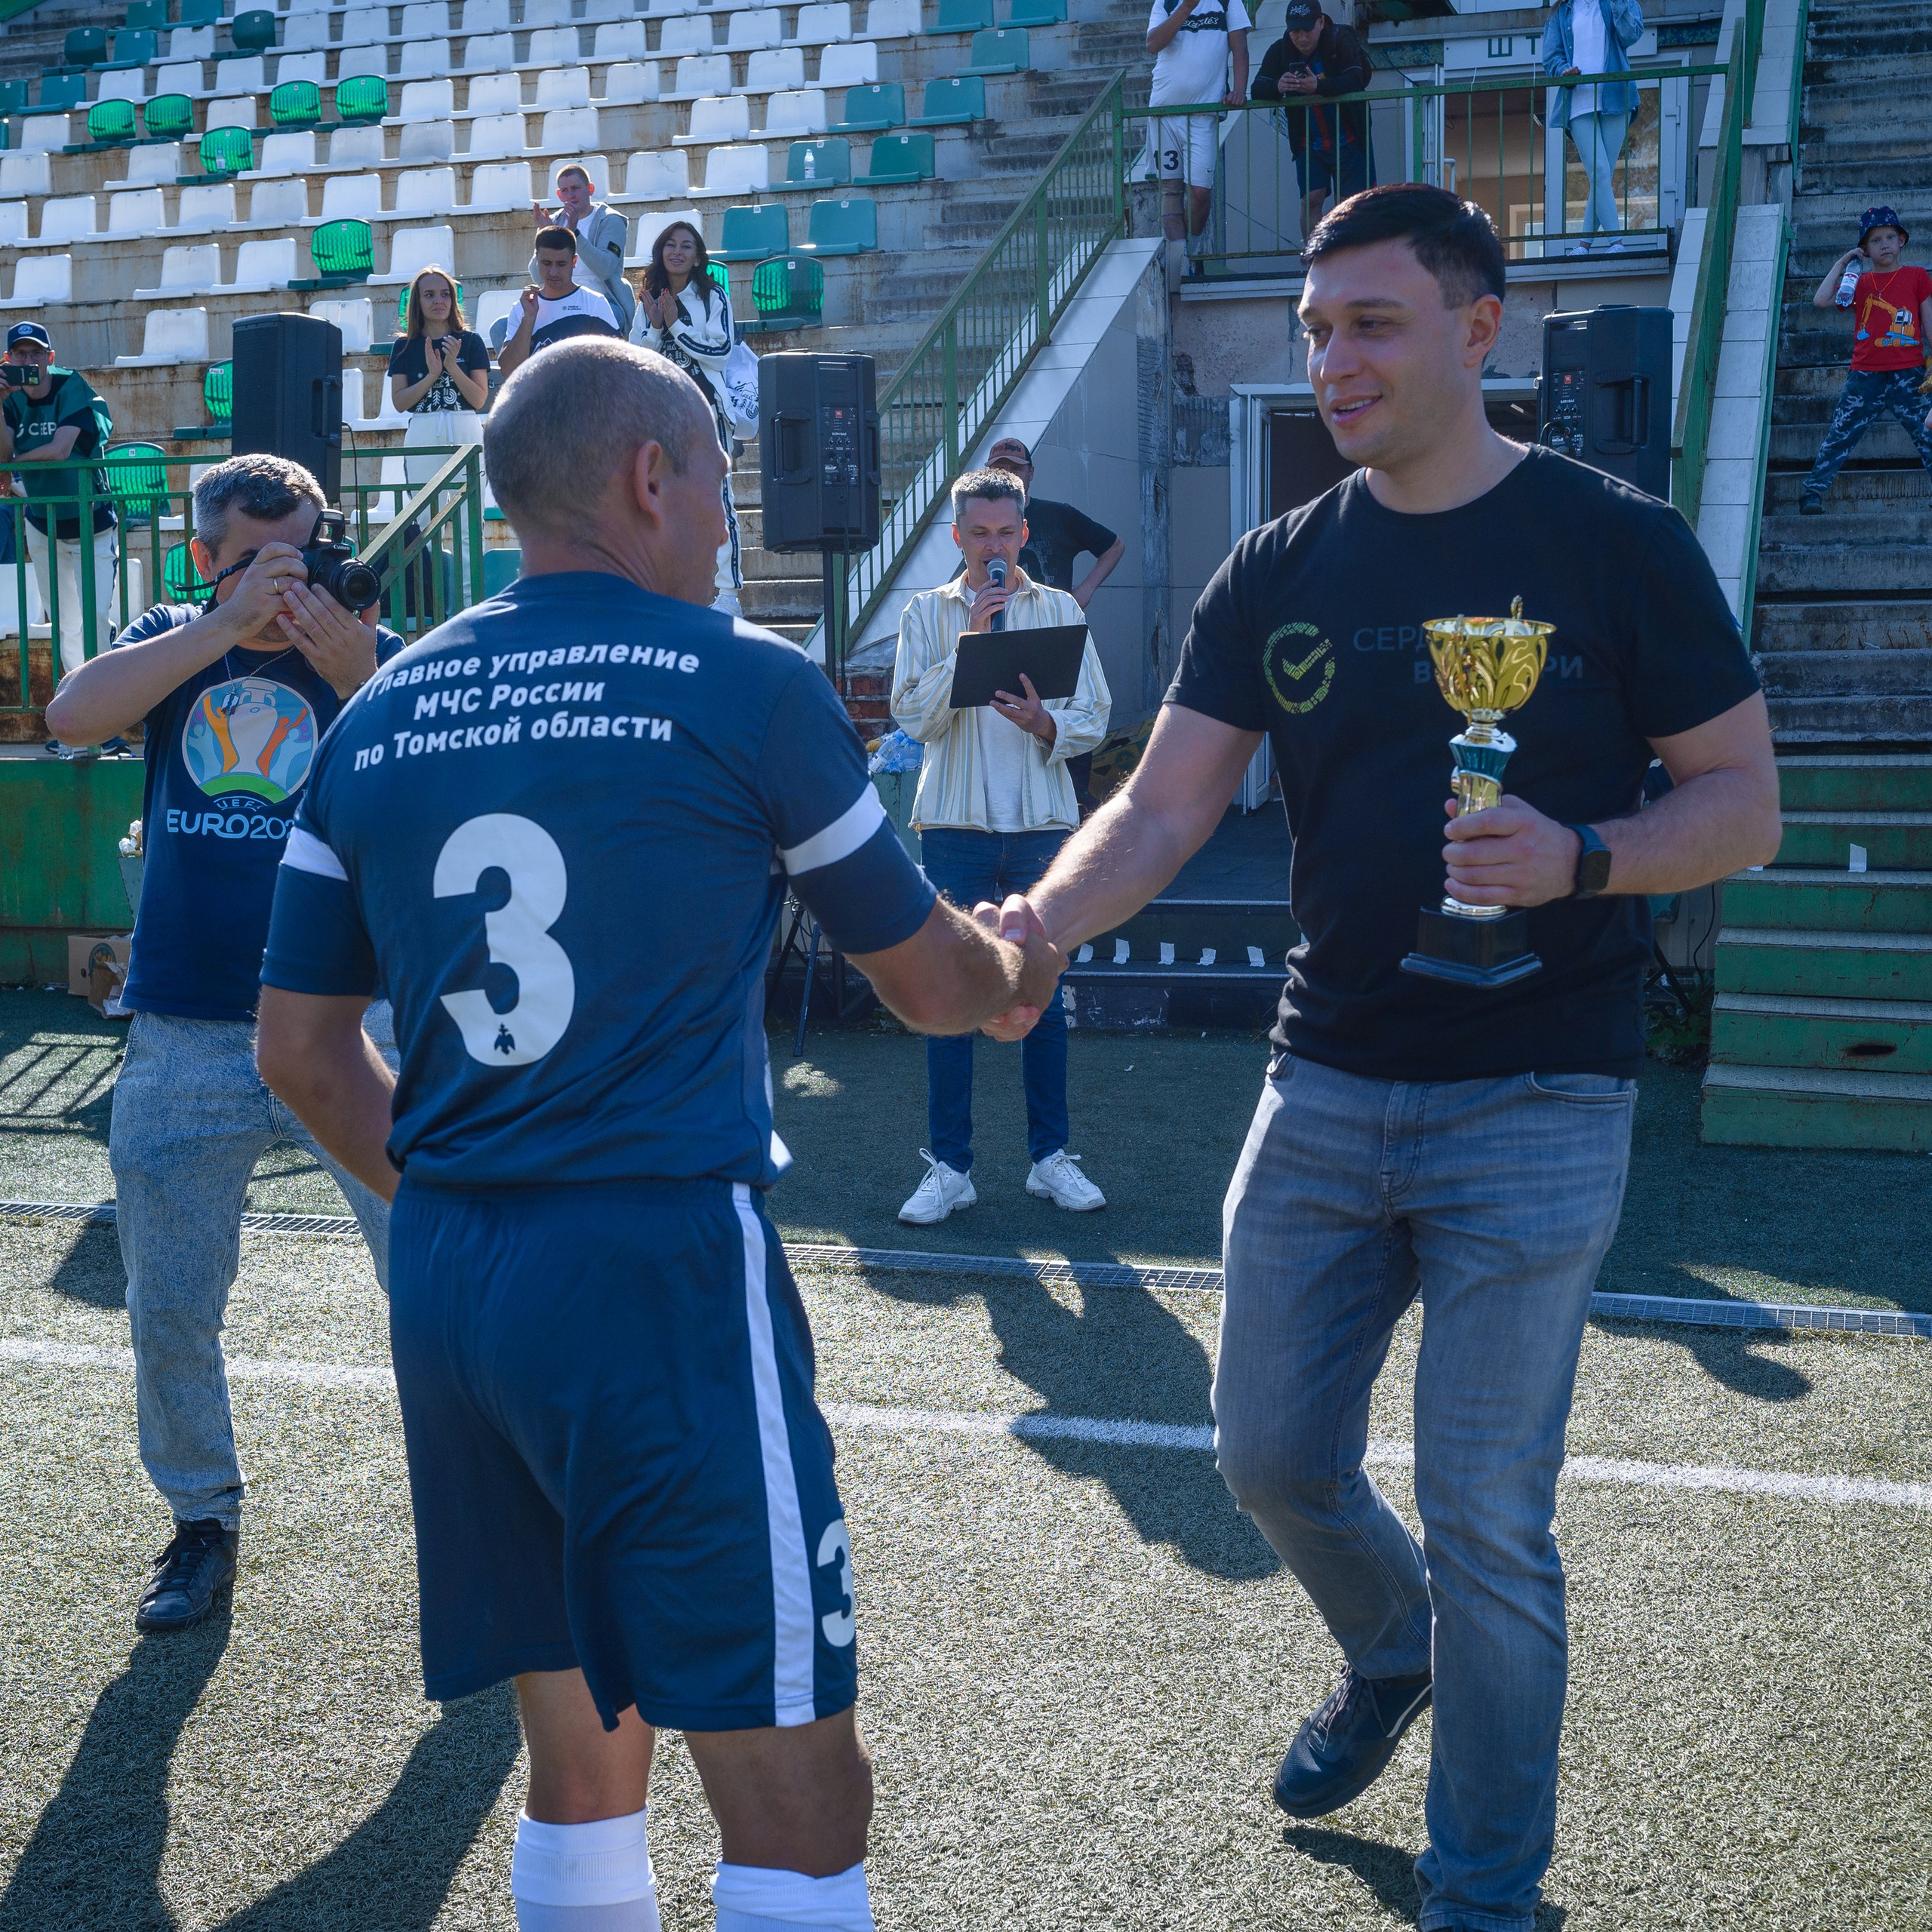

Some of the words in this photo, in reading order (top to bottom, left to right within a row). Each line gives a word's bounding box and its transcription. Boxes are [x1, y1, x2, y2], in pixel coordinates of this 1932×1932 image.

[1487, 35, 1541, 58] ШТ
[1153, 150, 1180, 171] 13
[1353, 626, 1426, 652] СЕР
[368, 656, 481, 702] Главное
[488, 644, 700, 678] управление
[413, 687, 481, 721] МЧС
[488, 681, 606, 710] России
[353, 743, 385, 771] по
[393, 715, 521, 758] Томской
[530, 710, 672, 742] области
[216, 798, 262, 810] UEF
[167, 809, 294, 839] EURO20
[432, 812, 576, 1067] 3
[817, 1518, 857, 1647] 3
